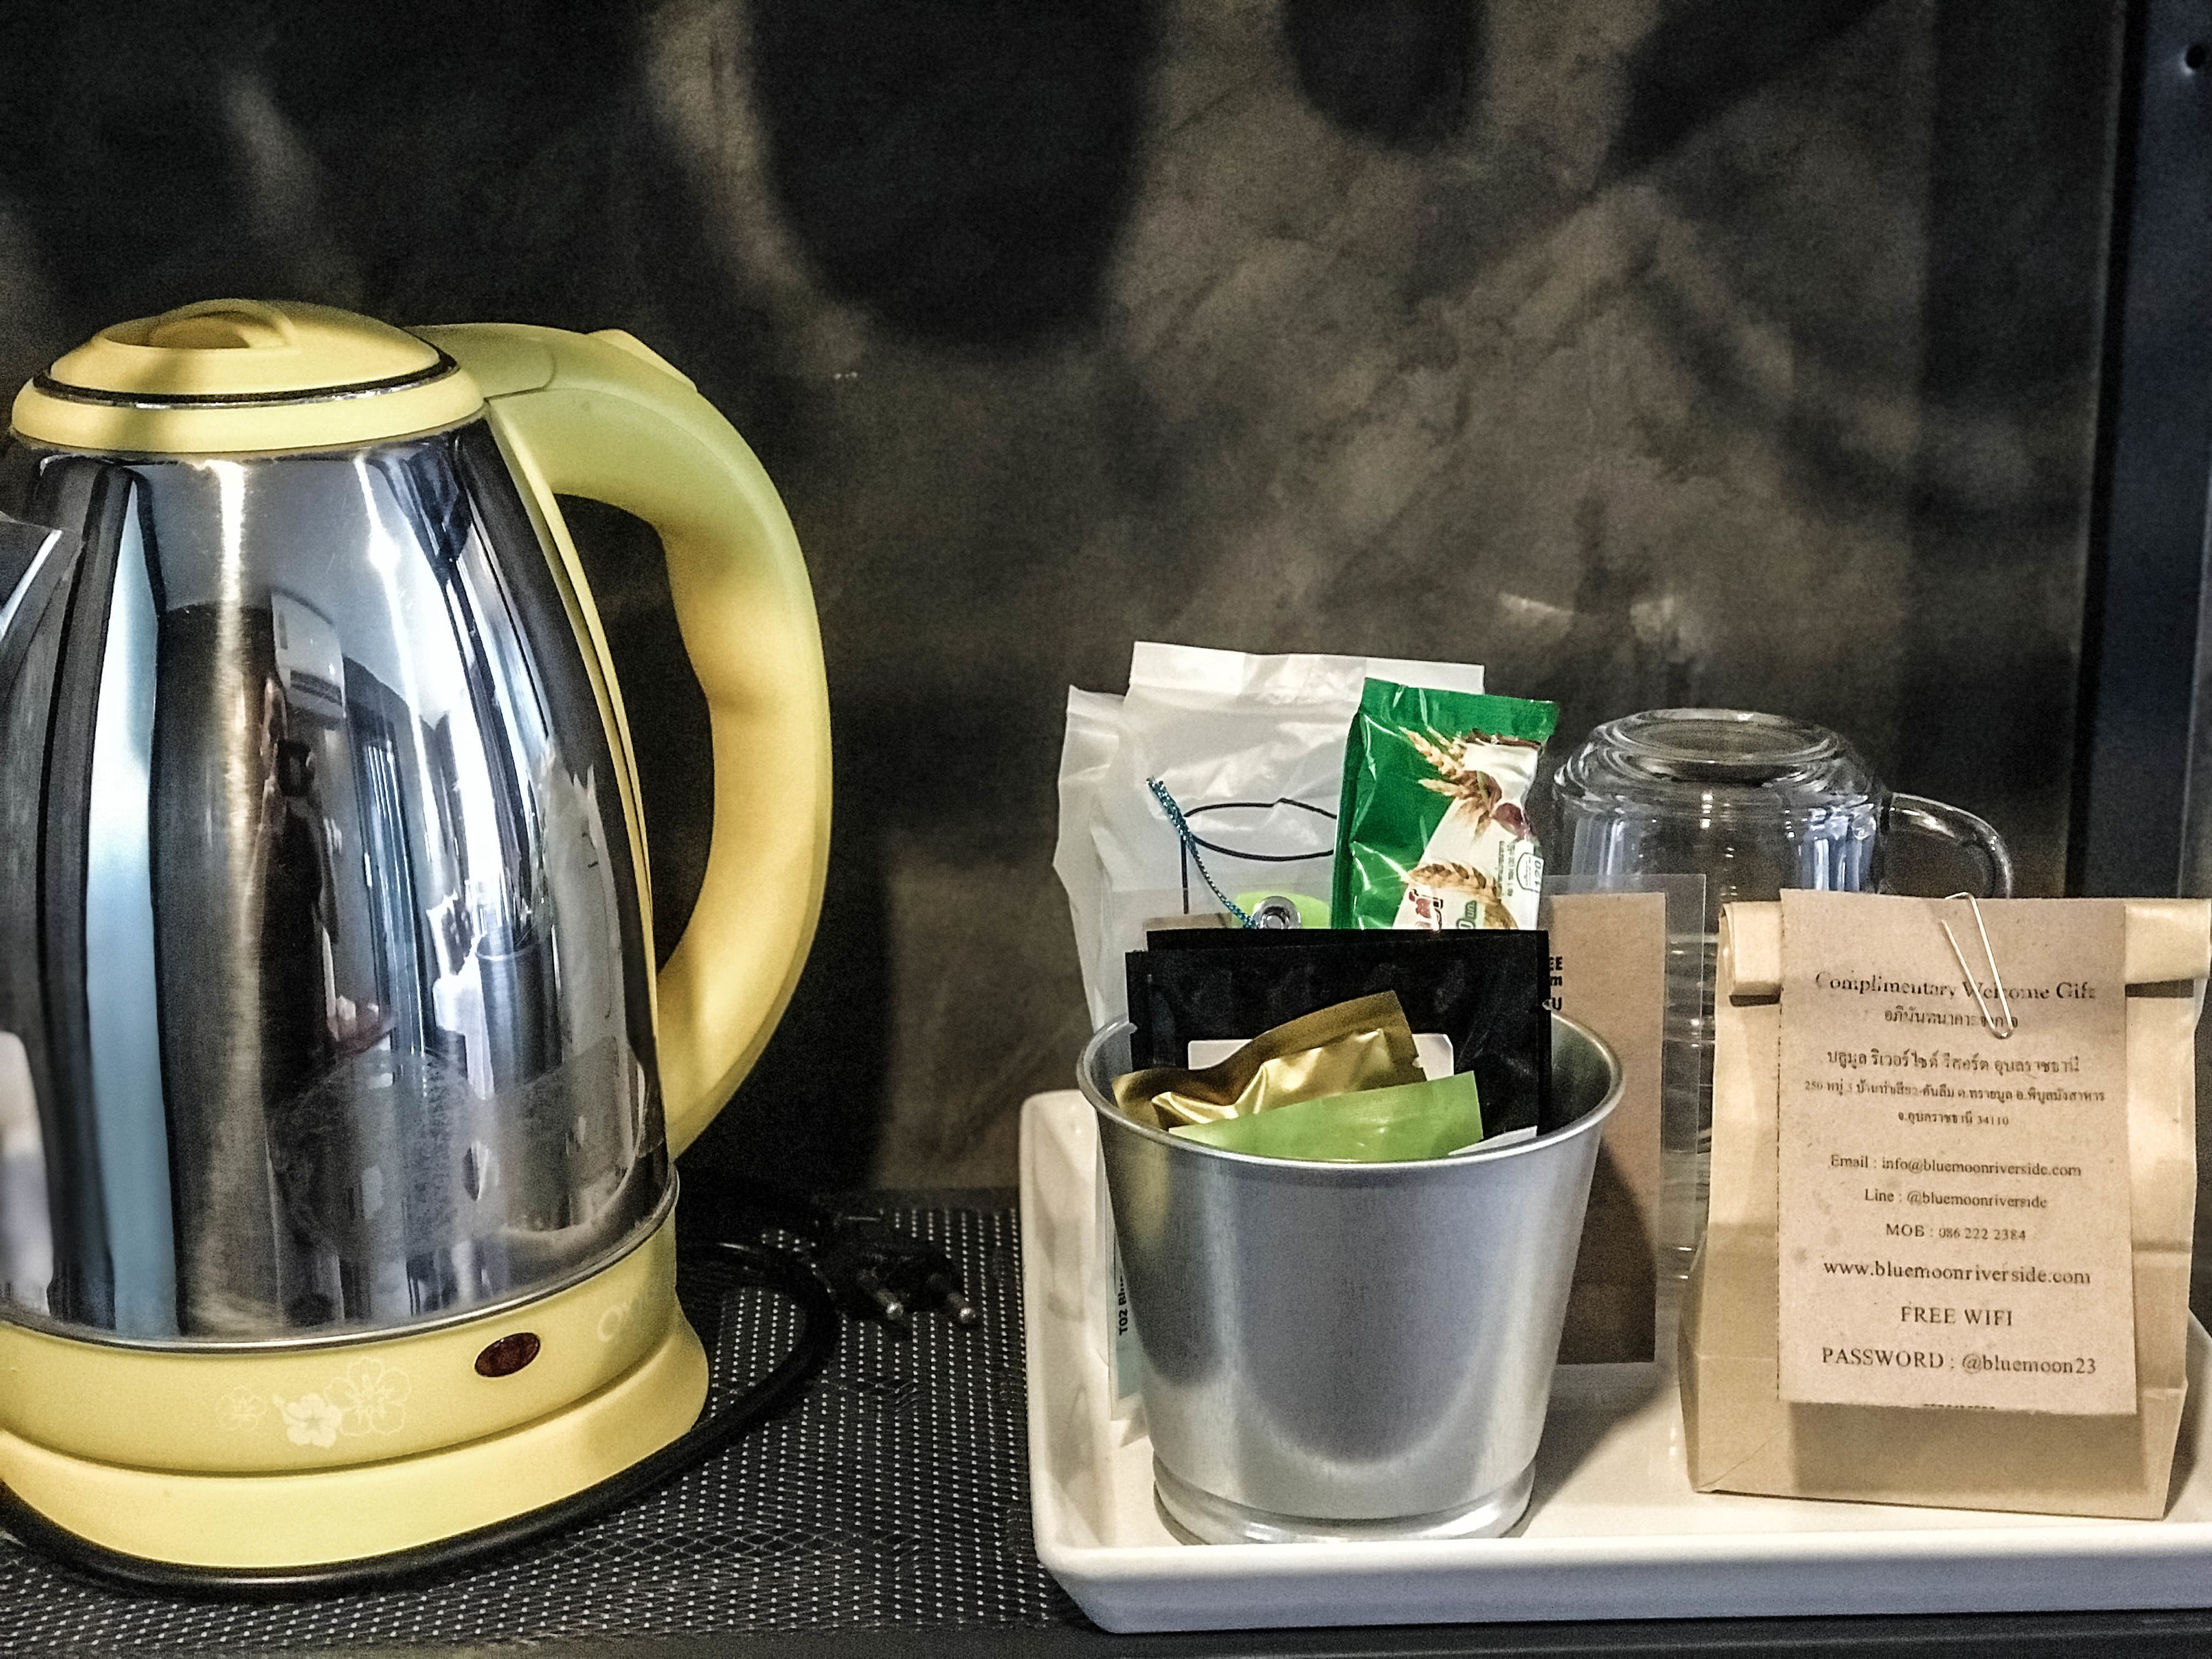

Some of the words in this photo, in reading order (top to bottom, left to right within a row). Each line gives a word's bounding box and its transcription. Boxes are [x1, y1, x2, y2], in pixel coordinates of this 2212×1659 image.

[1816, 971, 1957, 999] Complimentary
[1962, 980, 2050, 999] Welome
[2055, 981, 2096, 999] Gift
[1831, 1154, 1869, 1169] Email
[1881, 1156, 2082, 1177] info@bluemoonriverside.com
[1864, 1188, 1895, 1203] Line
[1906, 1190, 2048, 1209] @bluemoonriverside
[1886, 1223, 1926, 1237] MOB
[1964, 1228, 1989, 1240] 222
[1993, 1229, 2027, 1241] 2384
[1823, 1261, 2092, 1285] www.bluemoonriverside.com
[1900, 1305, 1957, 1324] FREE
[1964, 1308, 2013, 1326] WIFI
[1821, 1346, 1944, 1369] PASSWORD
[1962, 1353, 2097, 1375] @bluemoon23
